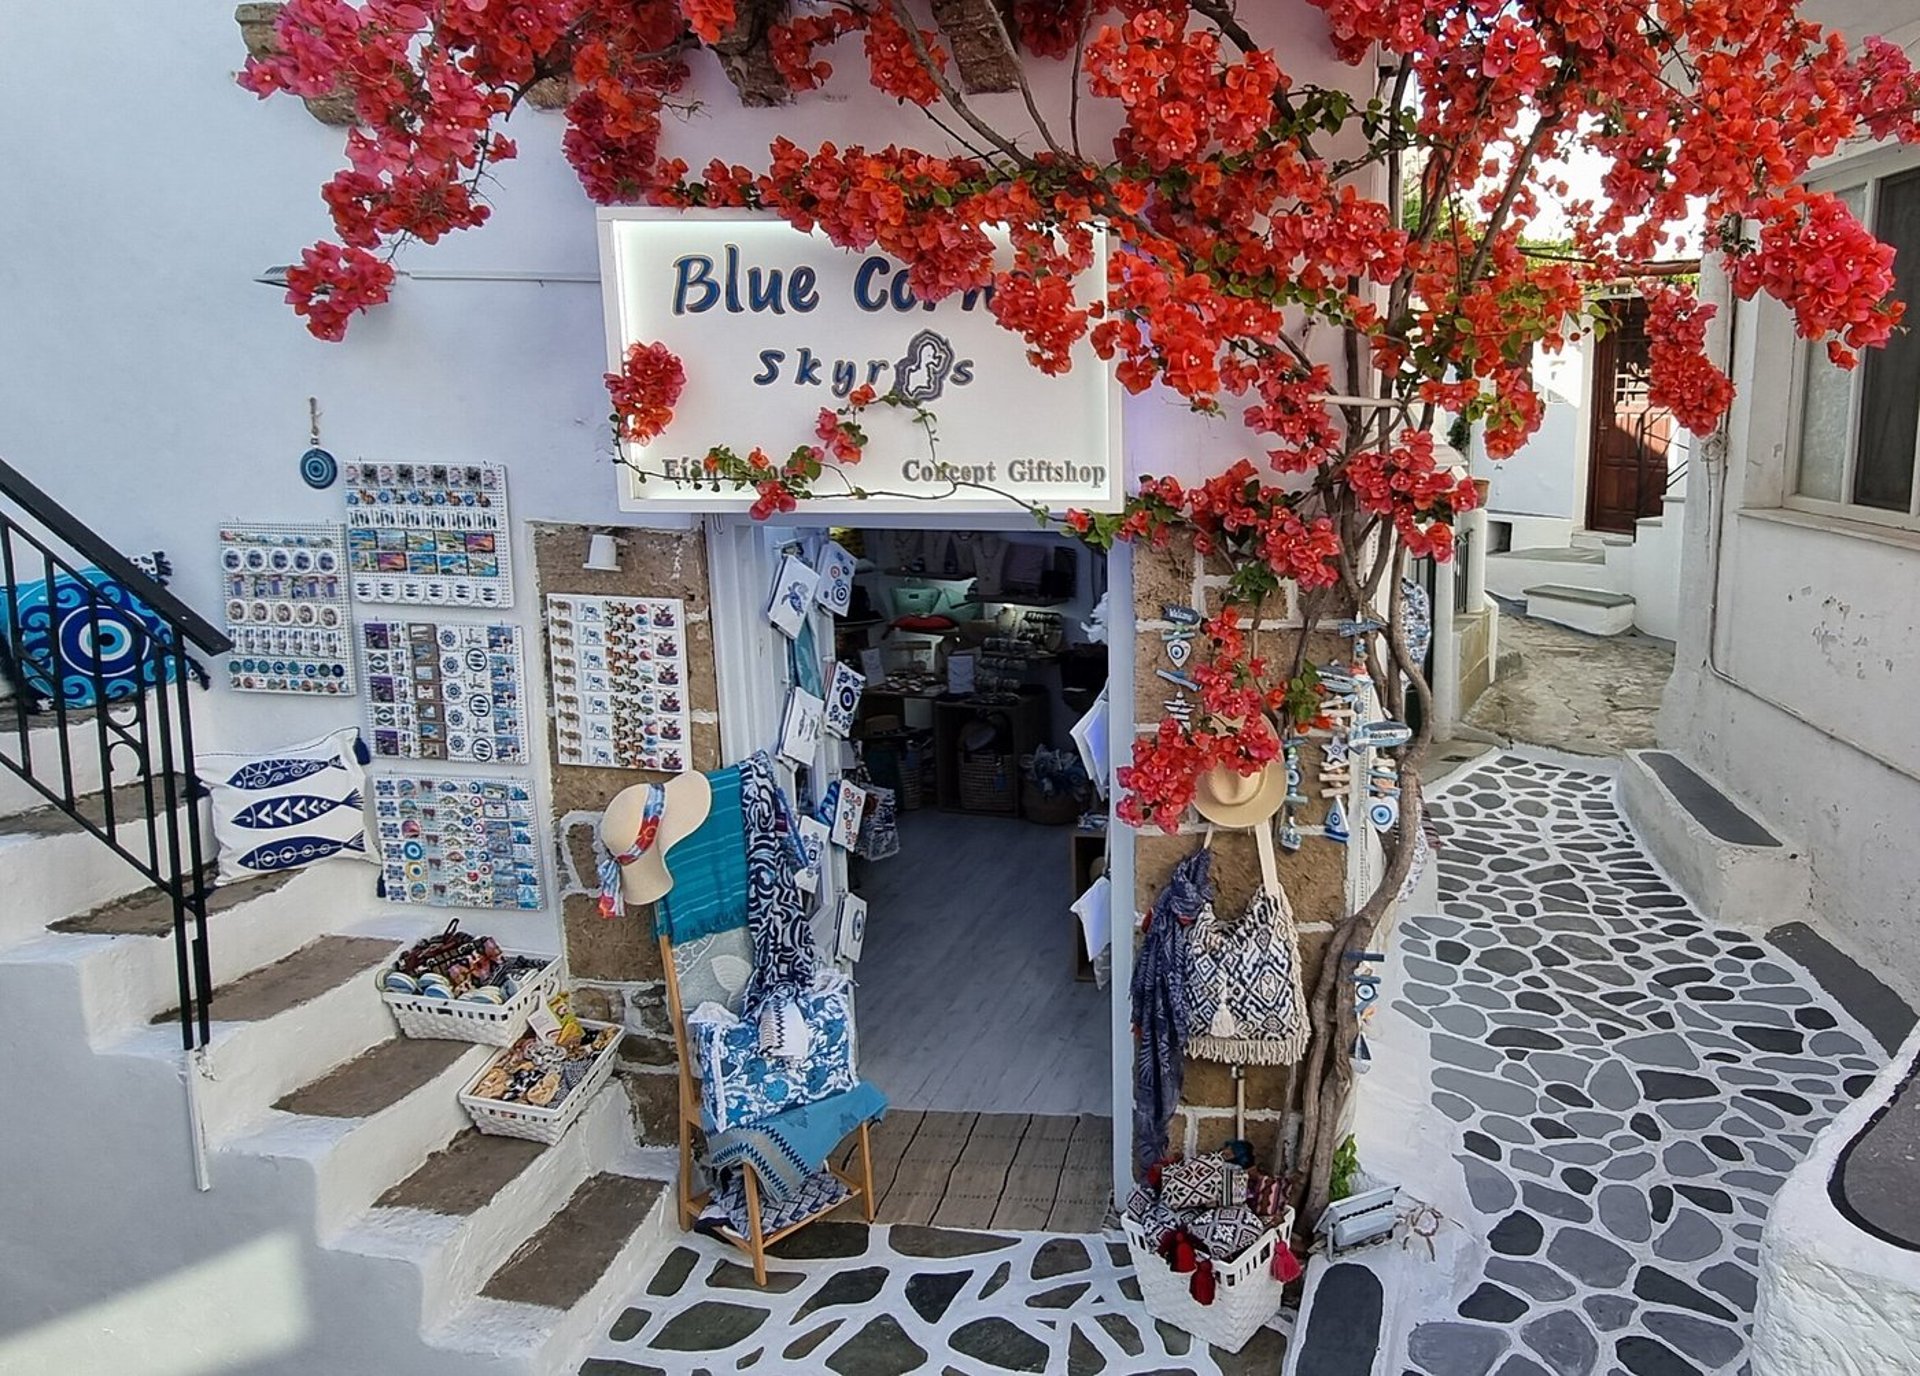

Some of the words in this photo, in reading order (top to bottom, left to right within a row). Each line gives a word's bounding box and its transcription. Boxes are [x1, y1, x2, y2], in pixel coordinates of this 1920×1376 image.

[672, 243, 820, 315] Blue
[902, 459, 996, 484] Concept
[1008, 459, 1106, 488] Giftshop
